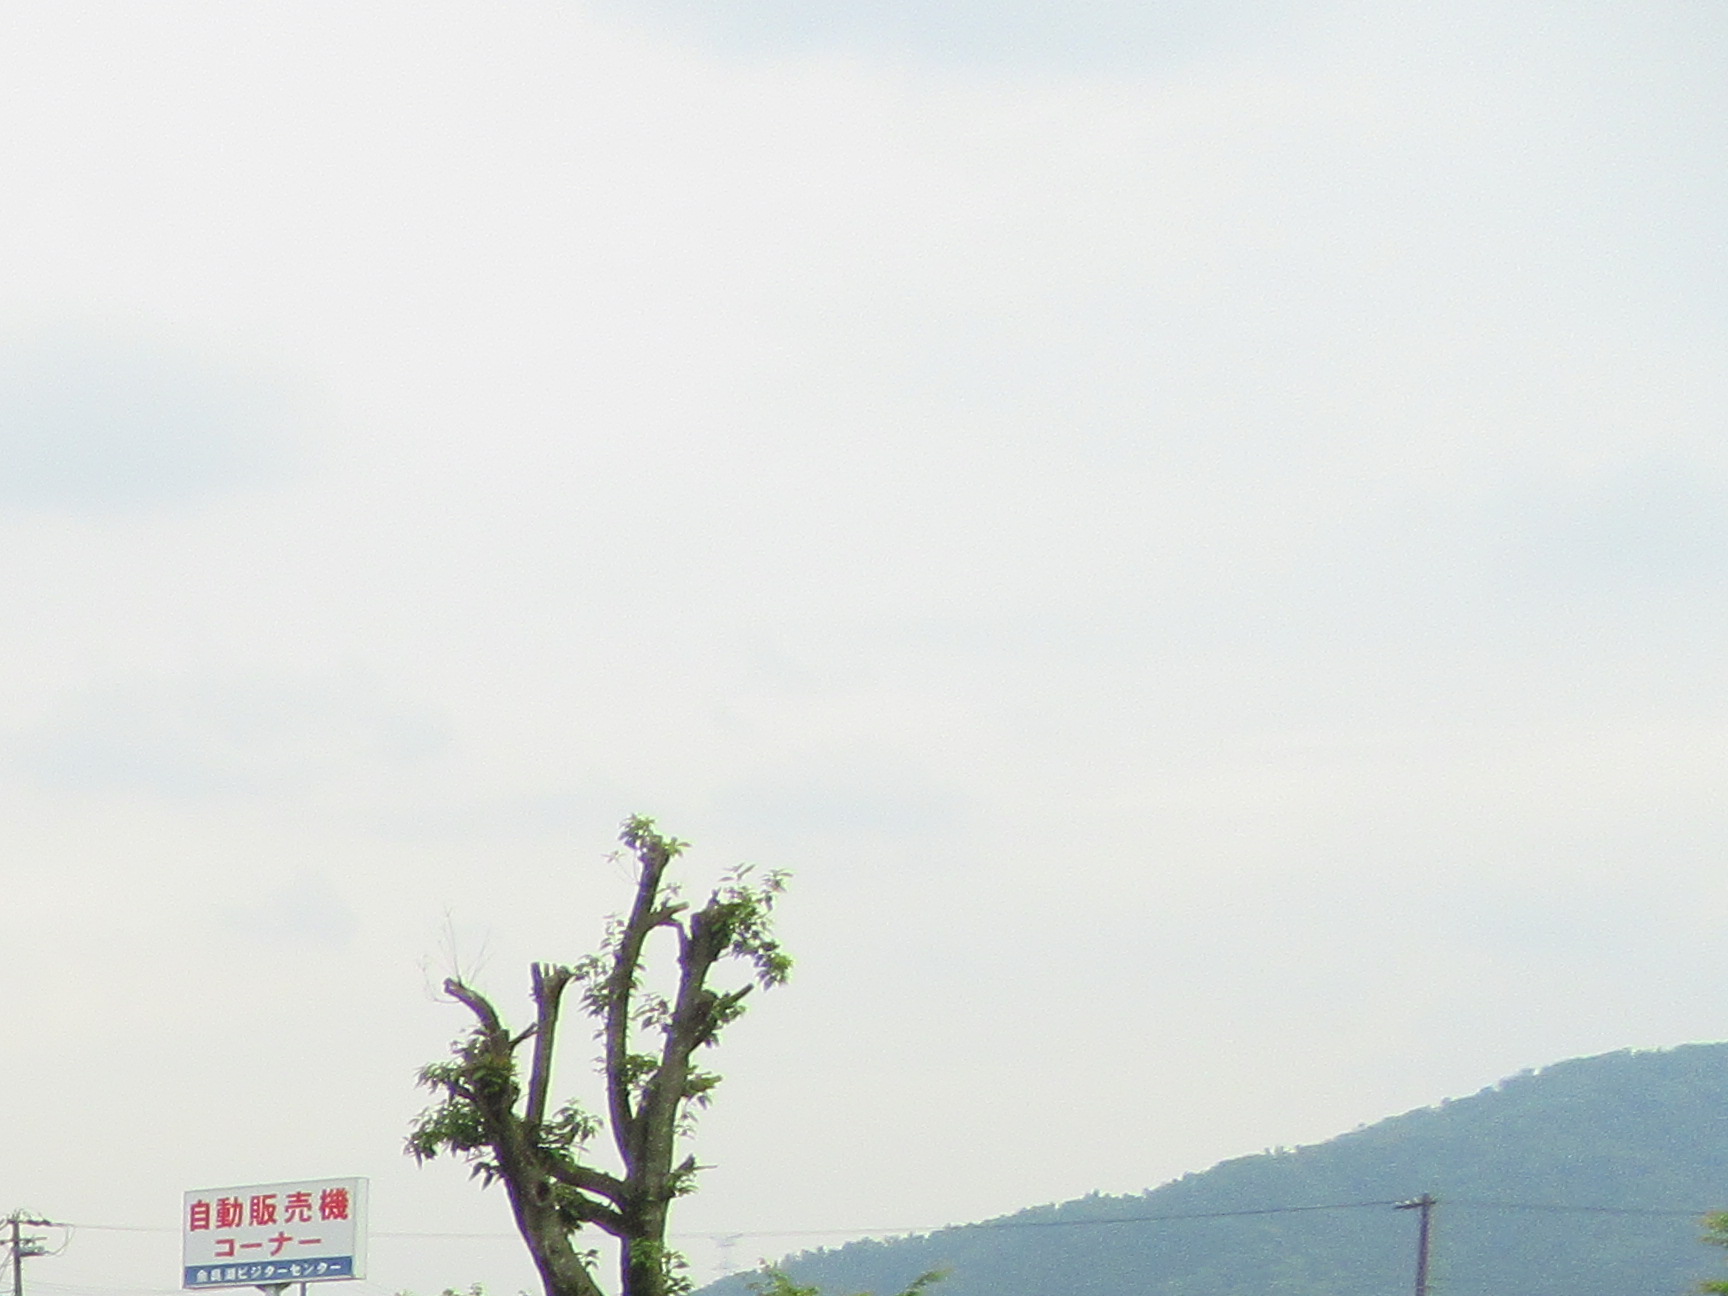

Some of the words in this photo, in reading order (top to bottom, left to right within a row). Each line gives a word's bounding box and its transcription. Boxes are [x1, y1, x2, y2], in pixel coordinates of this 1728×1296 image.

[189, 1187, 350, 1232] 自動販売機
[214, 1230, 322, 1258] コーナー
